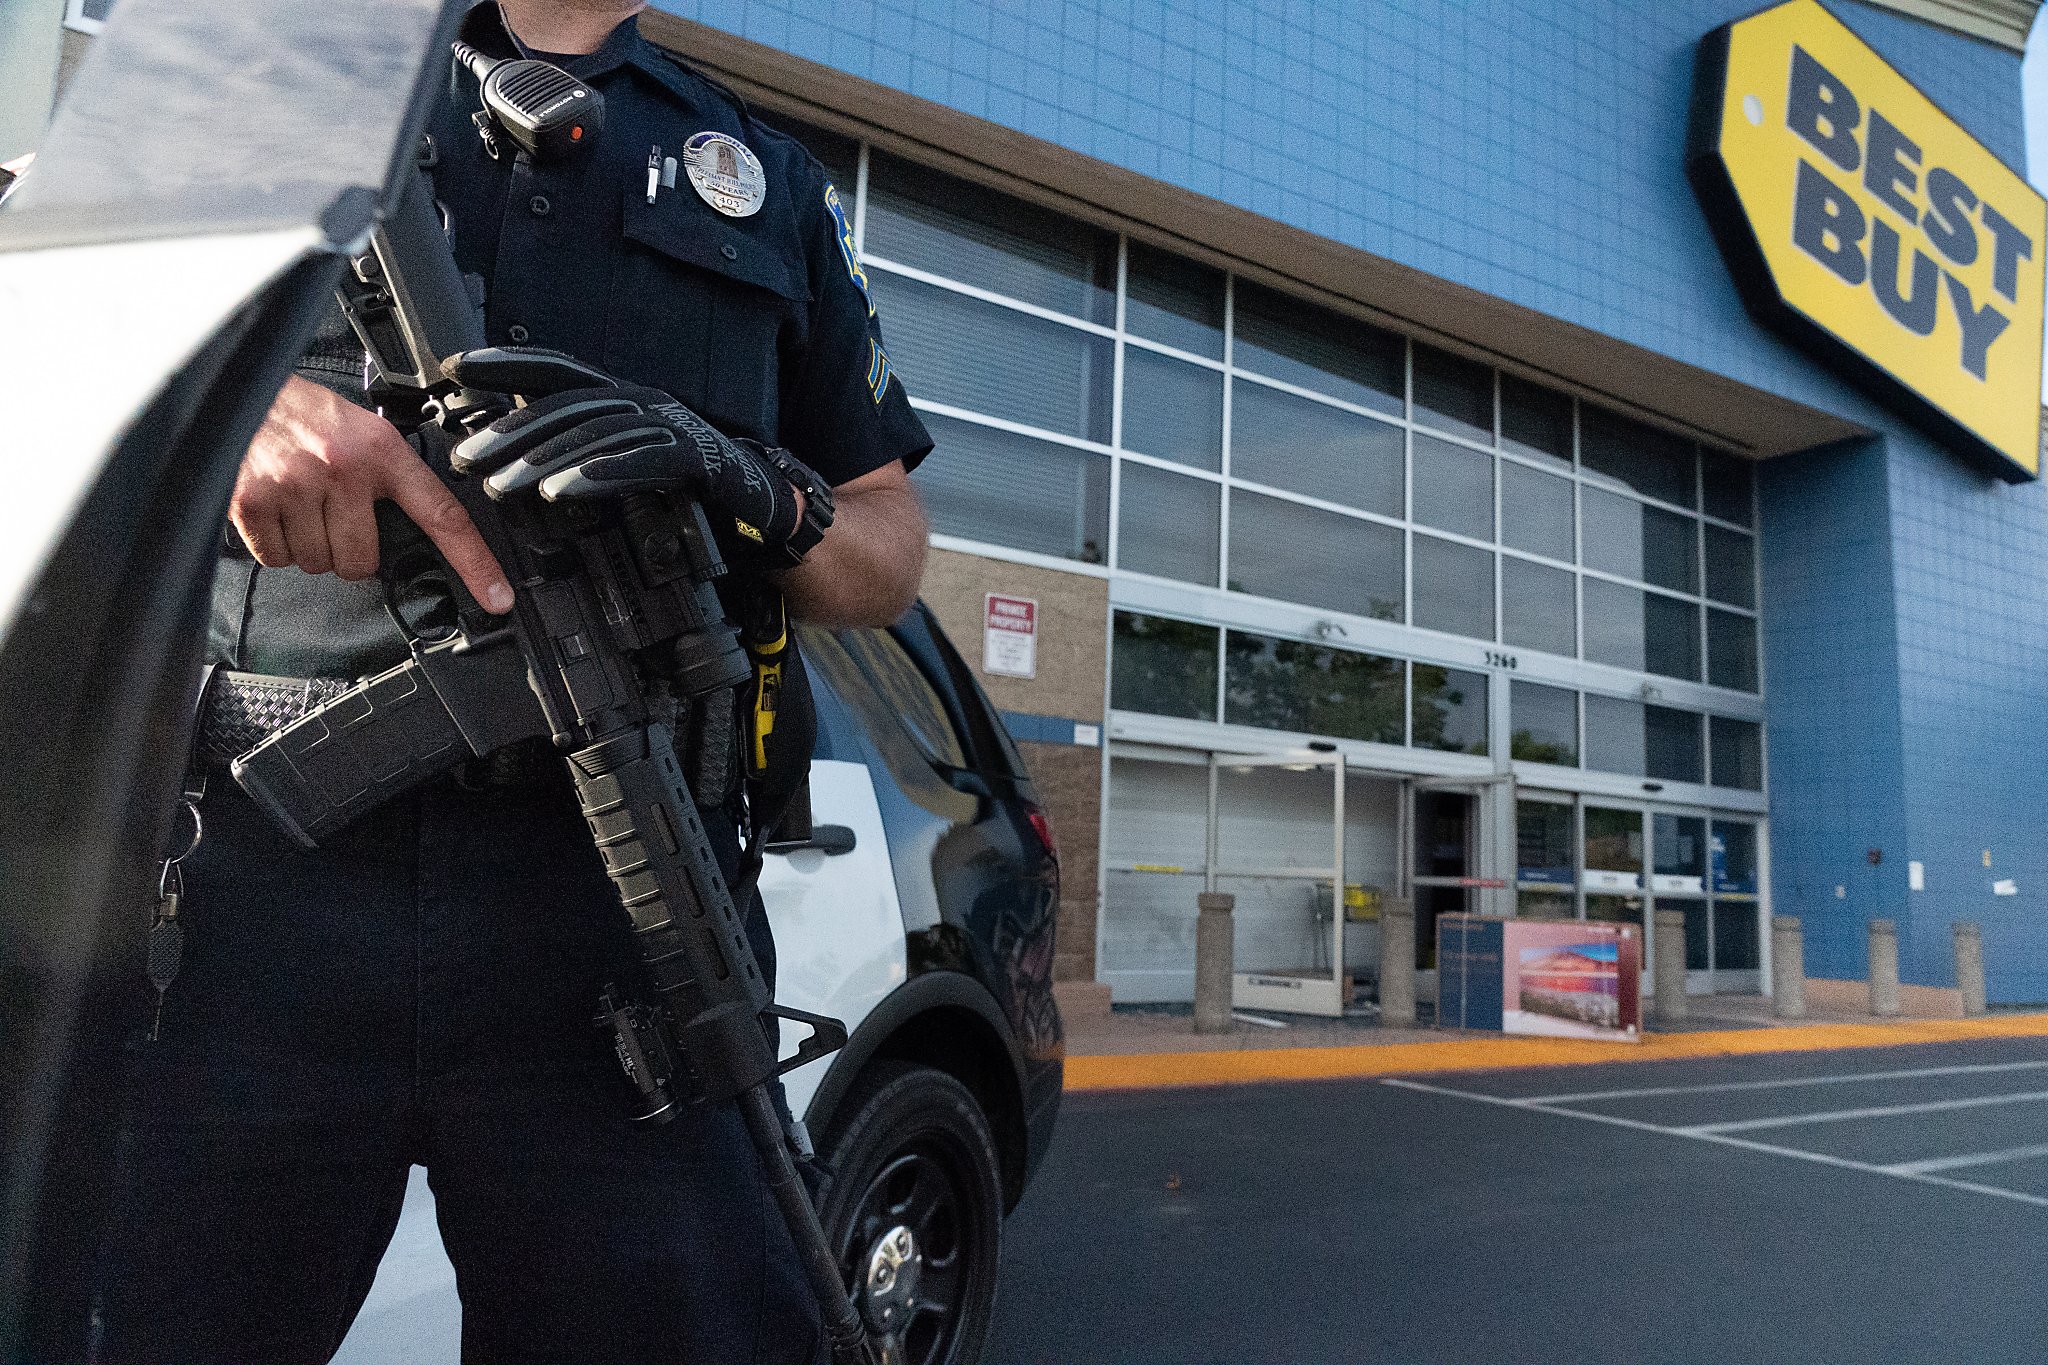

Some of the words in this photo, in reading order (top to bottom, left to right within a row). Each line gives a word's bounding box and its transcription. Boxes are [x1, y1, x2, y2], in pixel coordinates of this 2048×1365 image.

[1786, 43, 2033, 304] BEST
[722, 186, 749, 196] YEARS
[719, 197, 740, 207] 403
[1792, 157, 2011, 383] BUY
[1484, 651, 1517, 669] 3260
